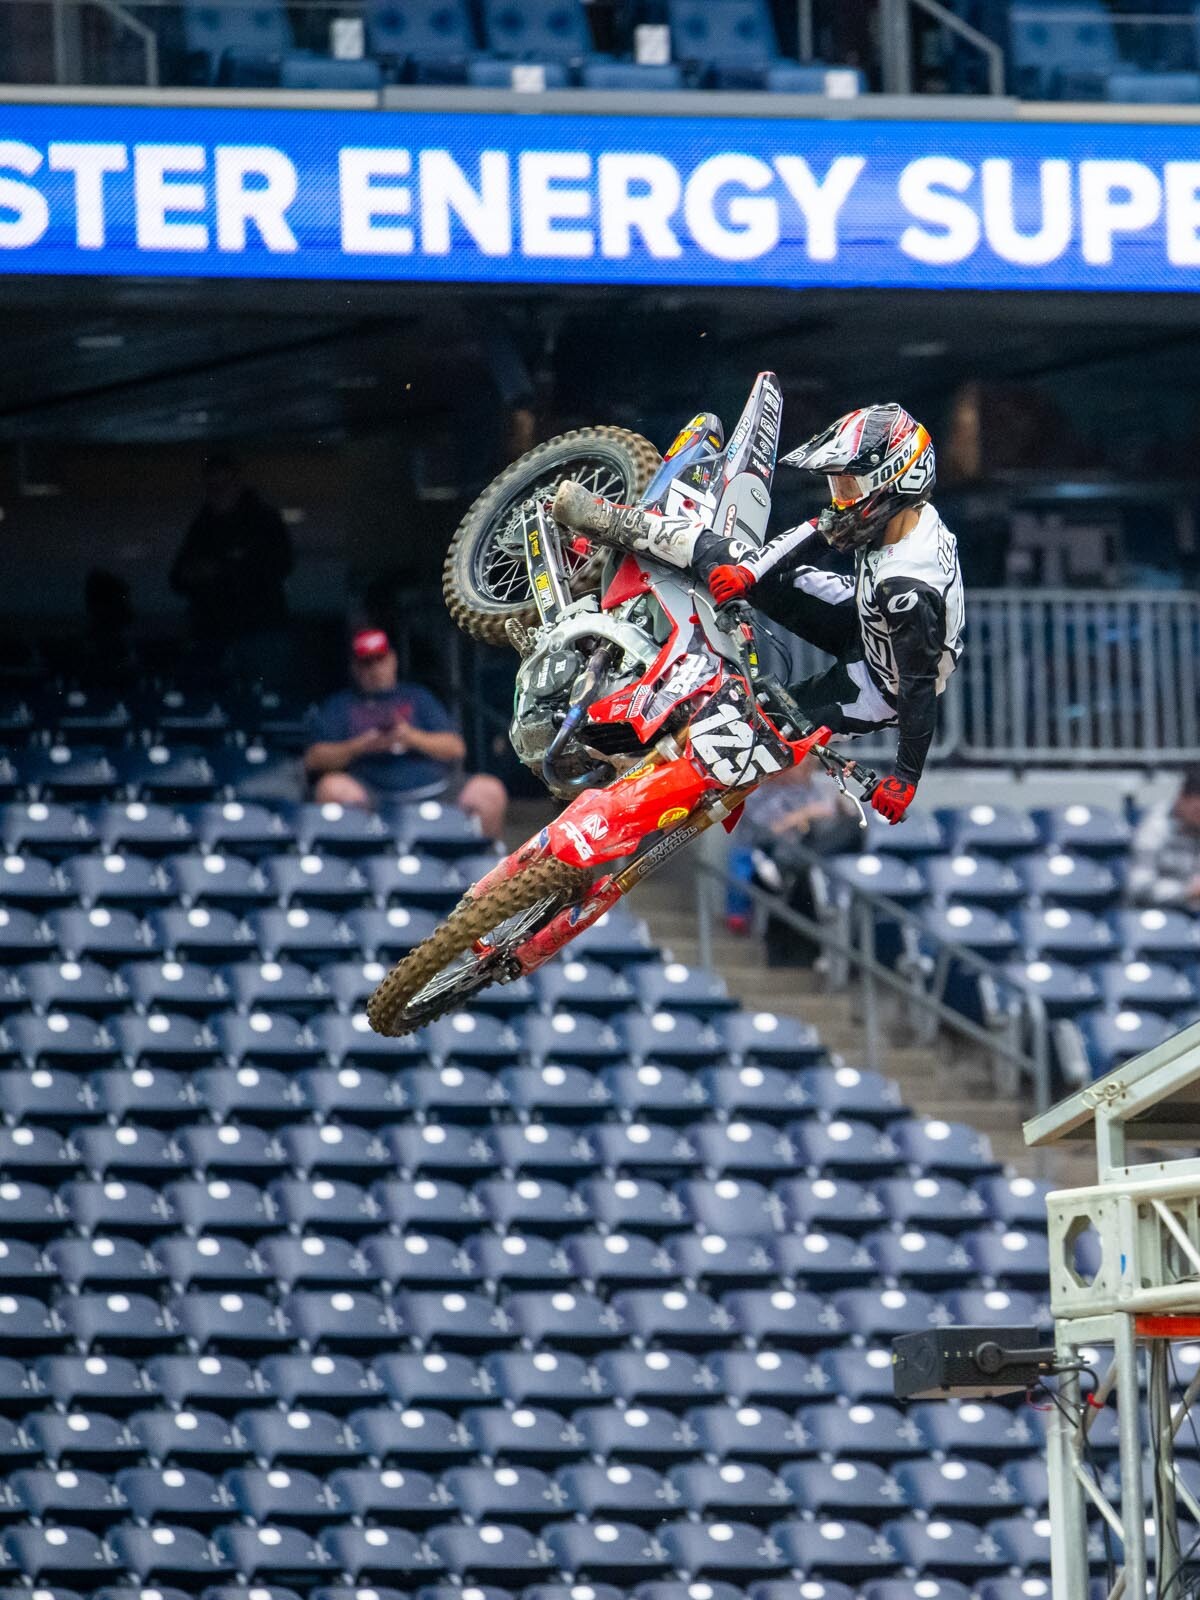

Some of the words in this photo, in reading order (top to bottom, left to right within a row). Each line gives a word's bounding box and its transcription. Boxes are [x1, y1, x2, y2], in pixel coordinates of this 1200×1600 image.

[340, 149, 863, 262] ENERGY
[870, 444, 916, 488] 100%
[689, 703, 782, 786] 125
